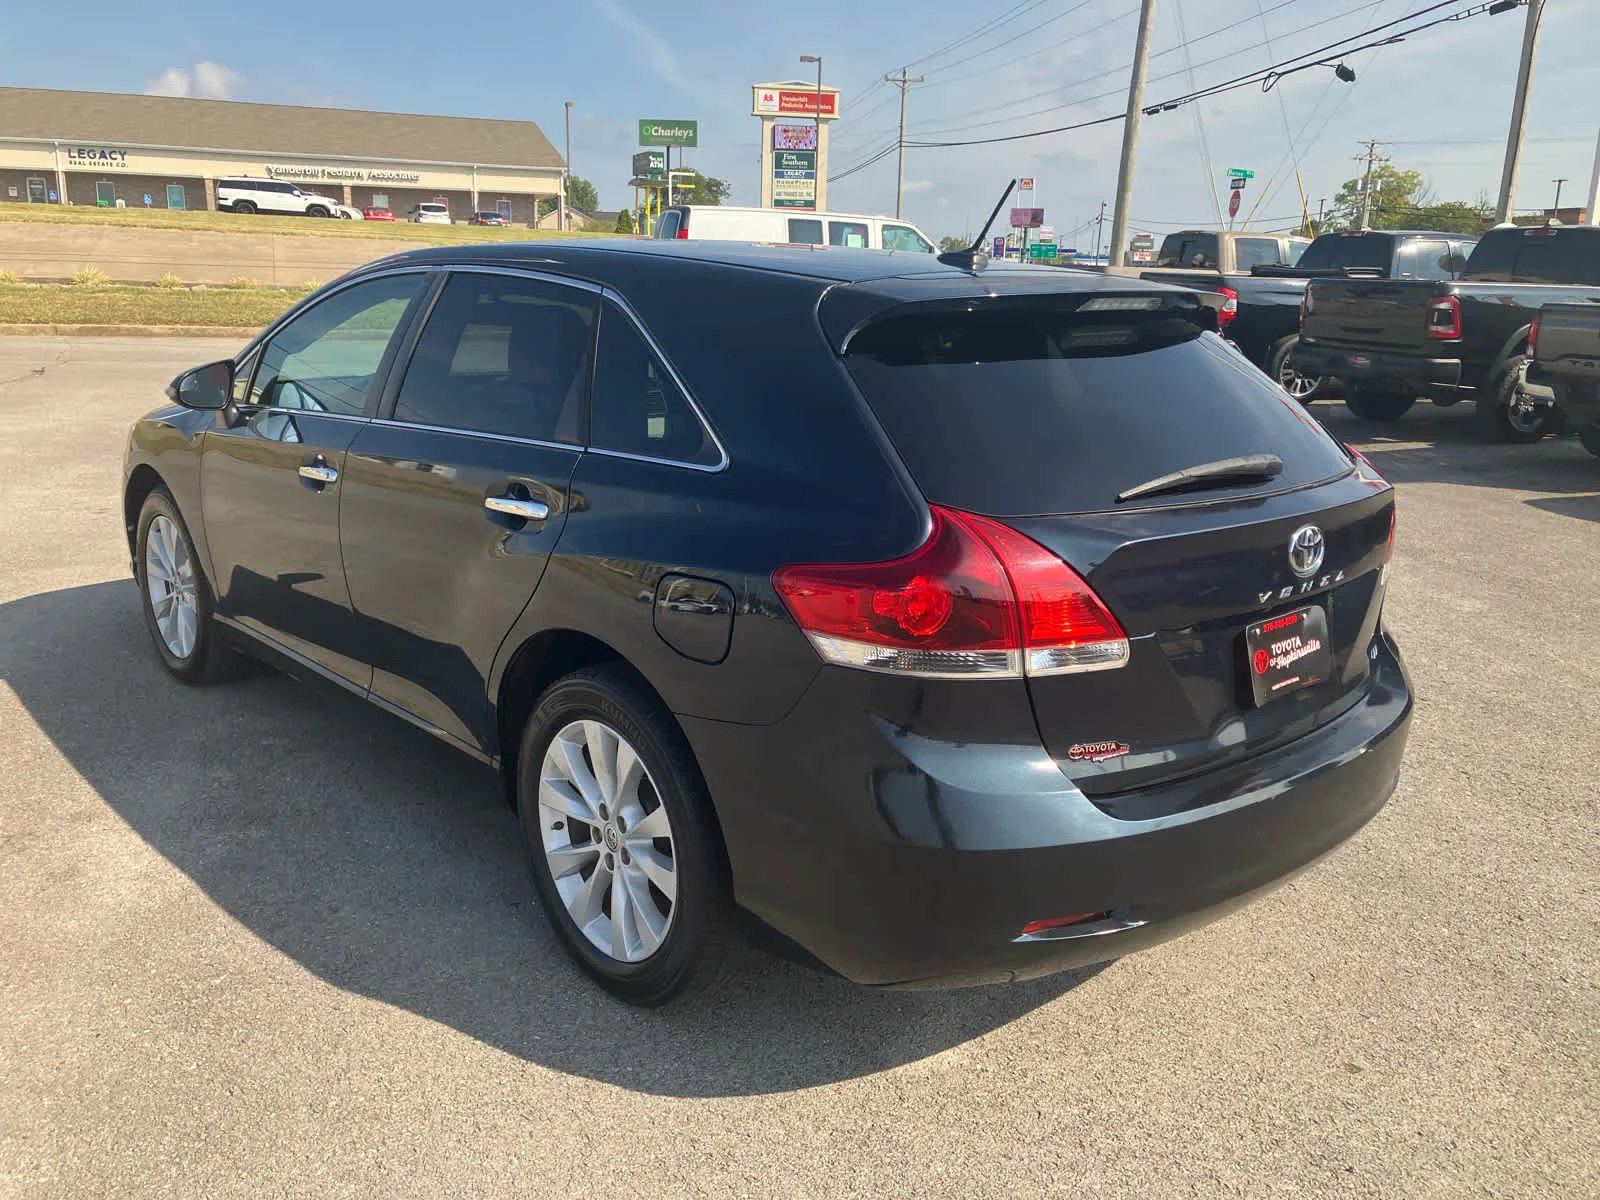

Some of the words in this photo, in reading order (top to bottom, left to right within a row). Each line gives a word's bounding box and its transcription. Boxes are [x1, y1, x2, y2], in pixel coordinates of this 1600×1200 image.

[68, 148, 128, 161] LEGACY
[1271, 635, 1302, 656] TOYOTA
[1085, 743, 1117, 753] TOYOTA
